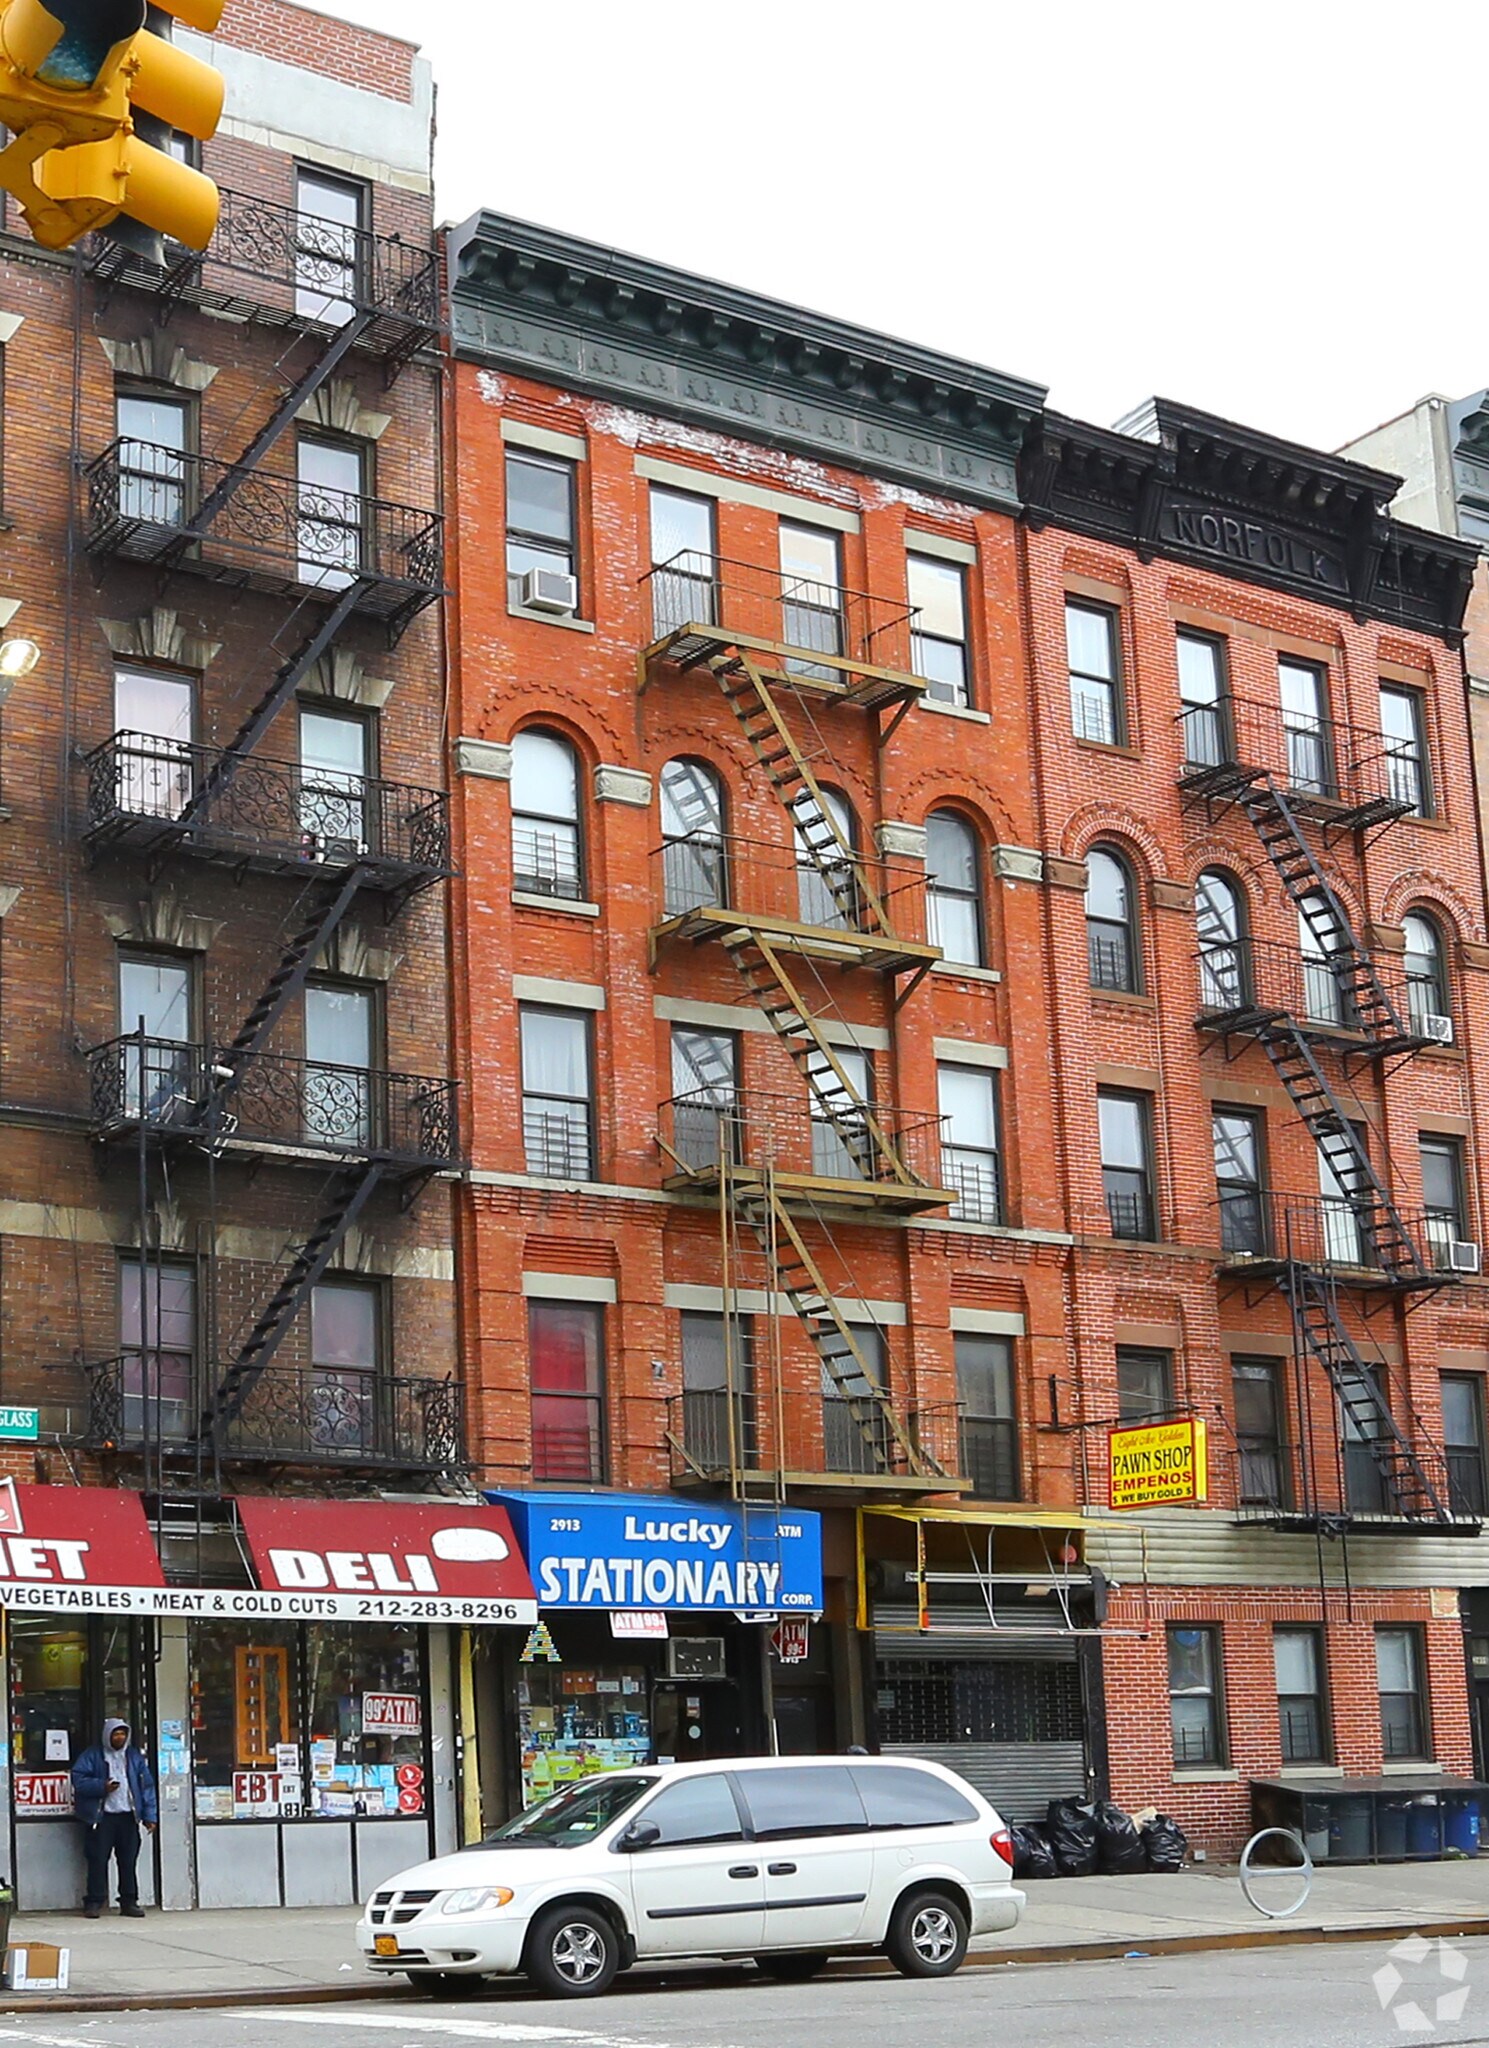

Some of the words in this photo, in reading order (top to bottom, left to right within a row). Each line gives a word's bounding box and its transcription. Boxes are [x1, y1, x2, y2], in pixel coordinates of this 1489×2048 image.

[1177, 511, 1327, 582] NORFOLK
[1113, 1450, 1152, 1476] PAWN
[1154, 1445, 1192, 1470] SHOP
[1113, 1471, 1192, 1492] EMPEÑOS
[1121, 1493, 1135, 1503] WE
[1137, 1491, 1156, 1501] BUY
[1157, 1488, 1183, 1498] GOLD
[550, 1518, 581, 1532] 2913
[624, 1516, 732, 1550] Lucky
[774, 1525, 802, 1538] ATM
[268, 1549, 440, 1592] DELI
[539, 1557, 781, 1605] STATIONARY
[1, 1587, 132, 1608] VEGETABLES
[153, 1594, 205, 1610] MEAT
[212, 1595, 226, 1611] &
[233, 1596, 282, 1612] COLD
[289, 1598, 337, 1614] CUTS
[358, 1600, 517, 1619] 212-283-8296
[784, 1624, 805, 1641] ATM
[235, 1773, 283, 1803] EBT
